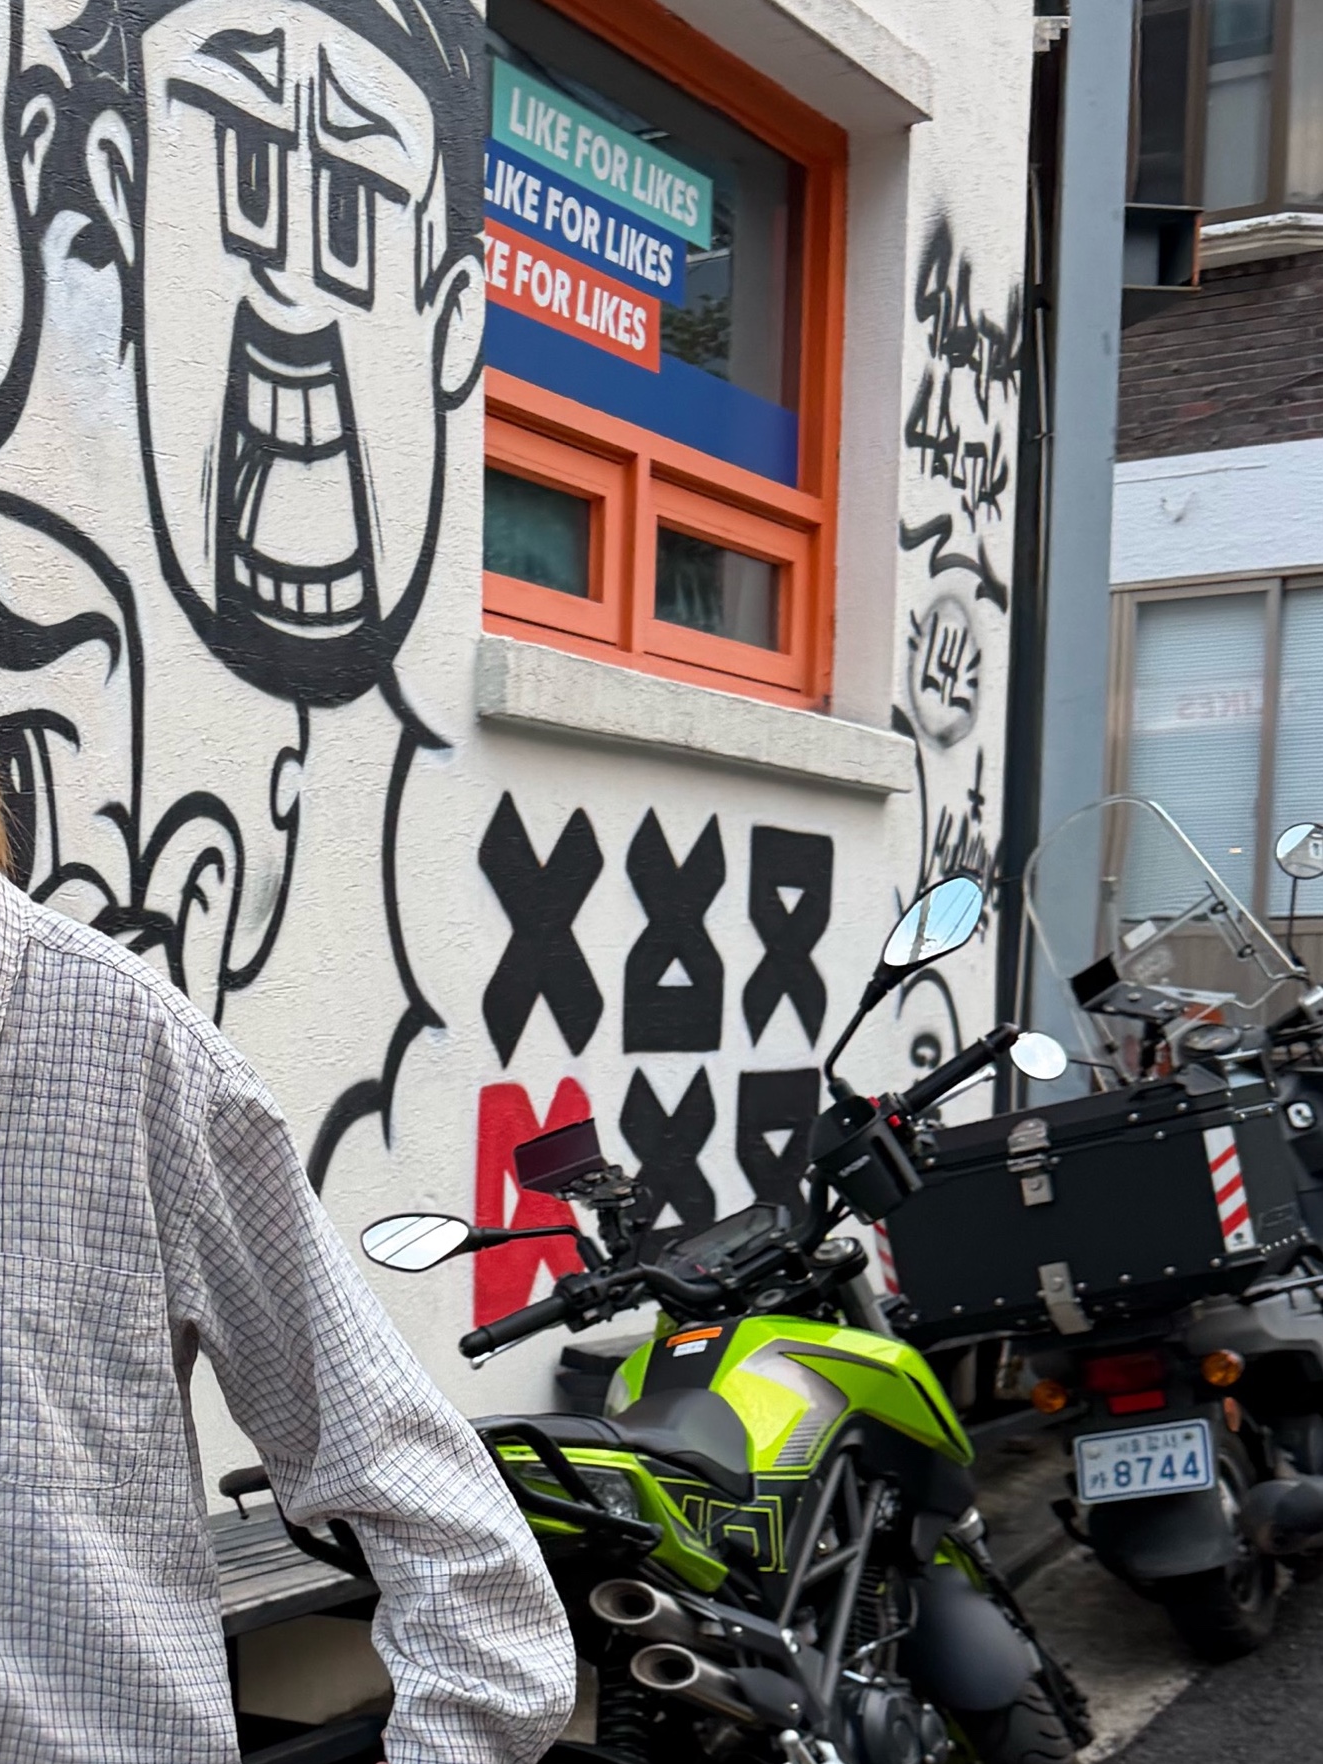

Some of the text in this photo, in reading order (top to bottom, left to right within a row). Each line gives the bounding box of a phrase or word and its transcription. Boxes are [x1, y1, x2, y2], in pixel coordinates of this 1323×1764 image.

[509, 87, 699, 227] LIKE FOR LIKES
[484, 153, 673, 287] LIKE FOR LIKES
[513, 250, 572, 318] FOR
[575, 280, 647, 351] LIKES
[1114, 1451, 1199, 1487] 8744
